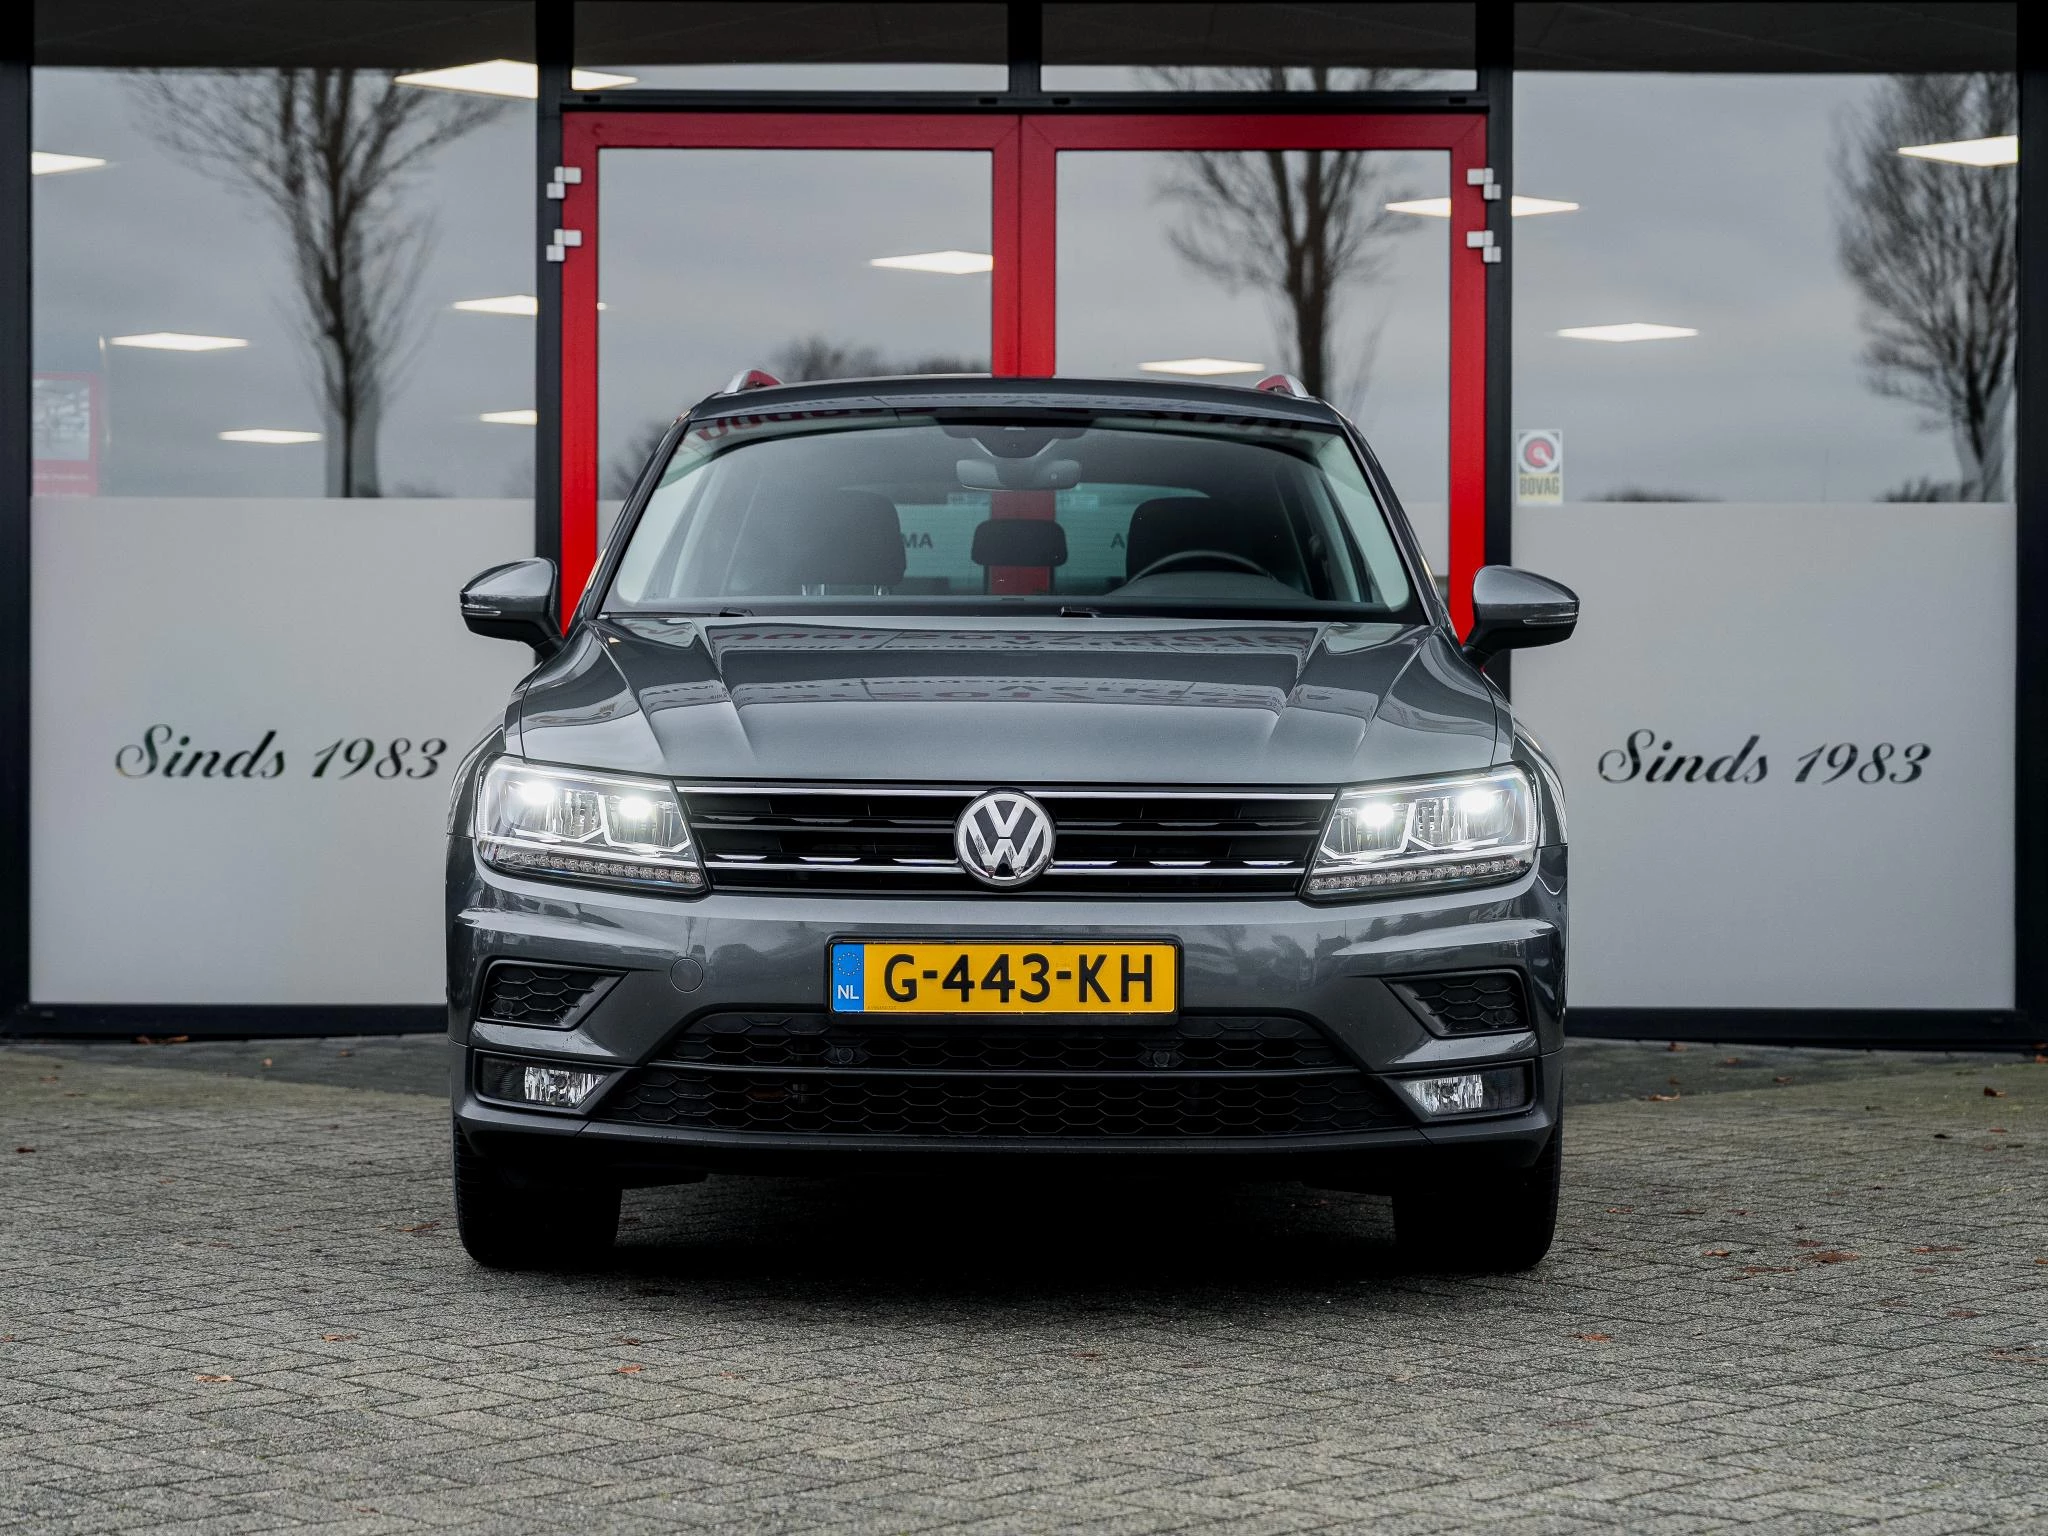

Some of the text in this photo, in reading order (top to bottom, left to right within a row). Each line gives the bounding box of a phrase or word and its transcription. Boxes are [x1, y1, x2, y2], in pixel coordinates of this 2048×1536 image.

[1519, 477, 1560, 496] BOVAG
[115, 723, 448, 781] Sinds 1983
[1598, 728, 1932, 786] Sinds 1983
[837, 984, 860, 1000] NL
[884, 953, 1153, 1003] G-443-KH
